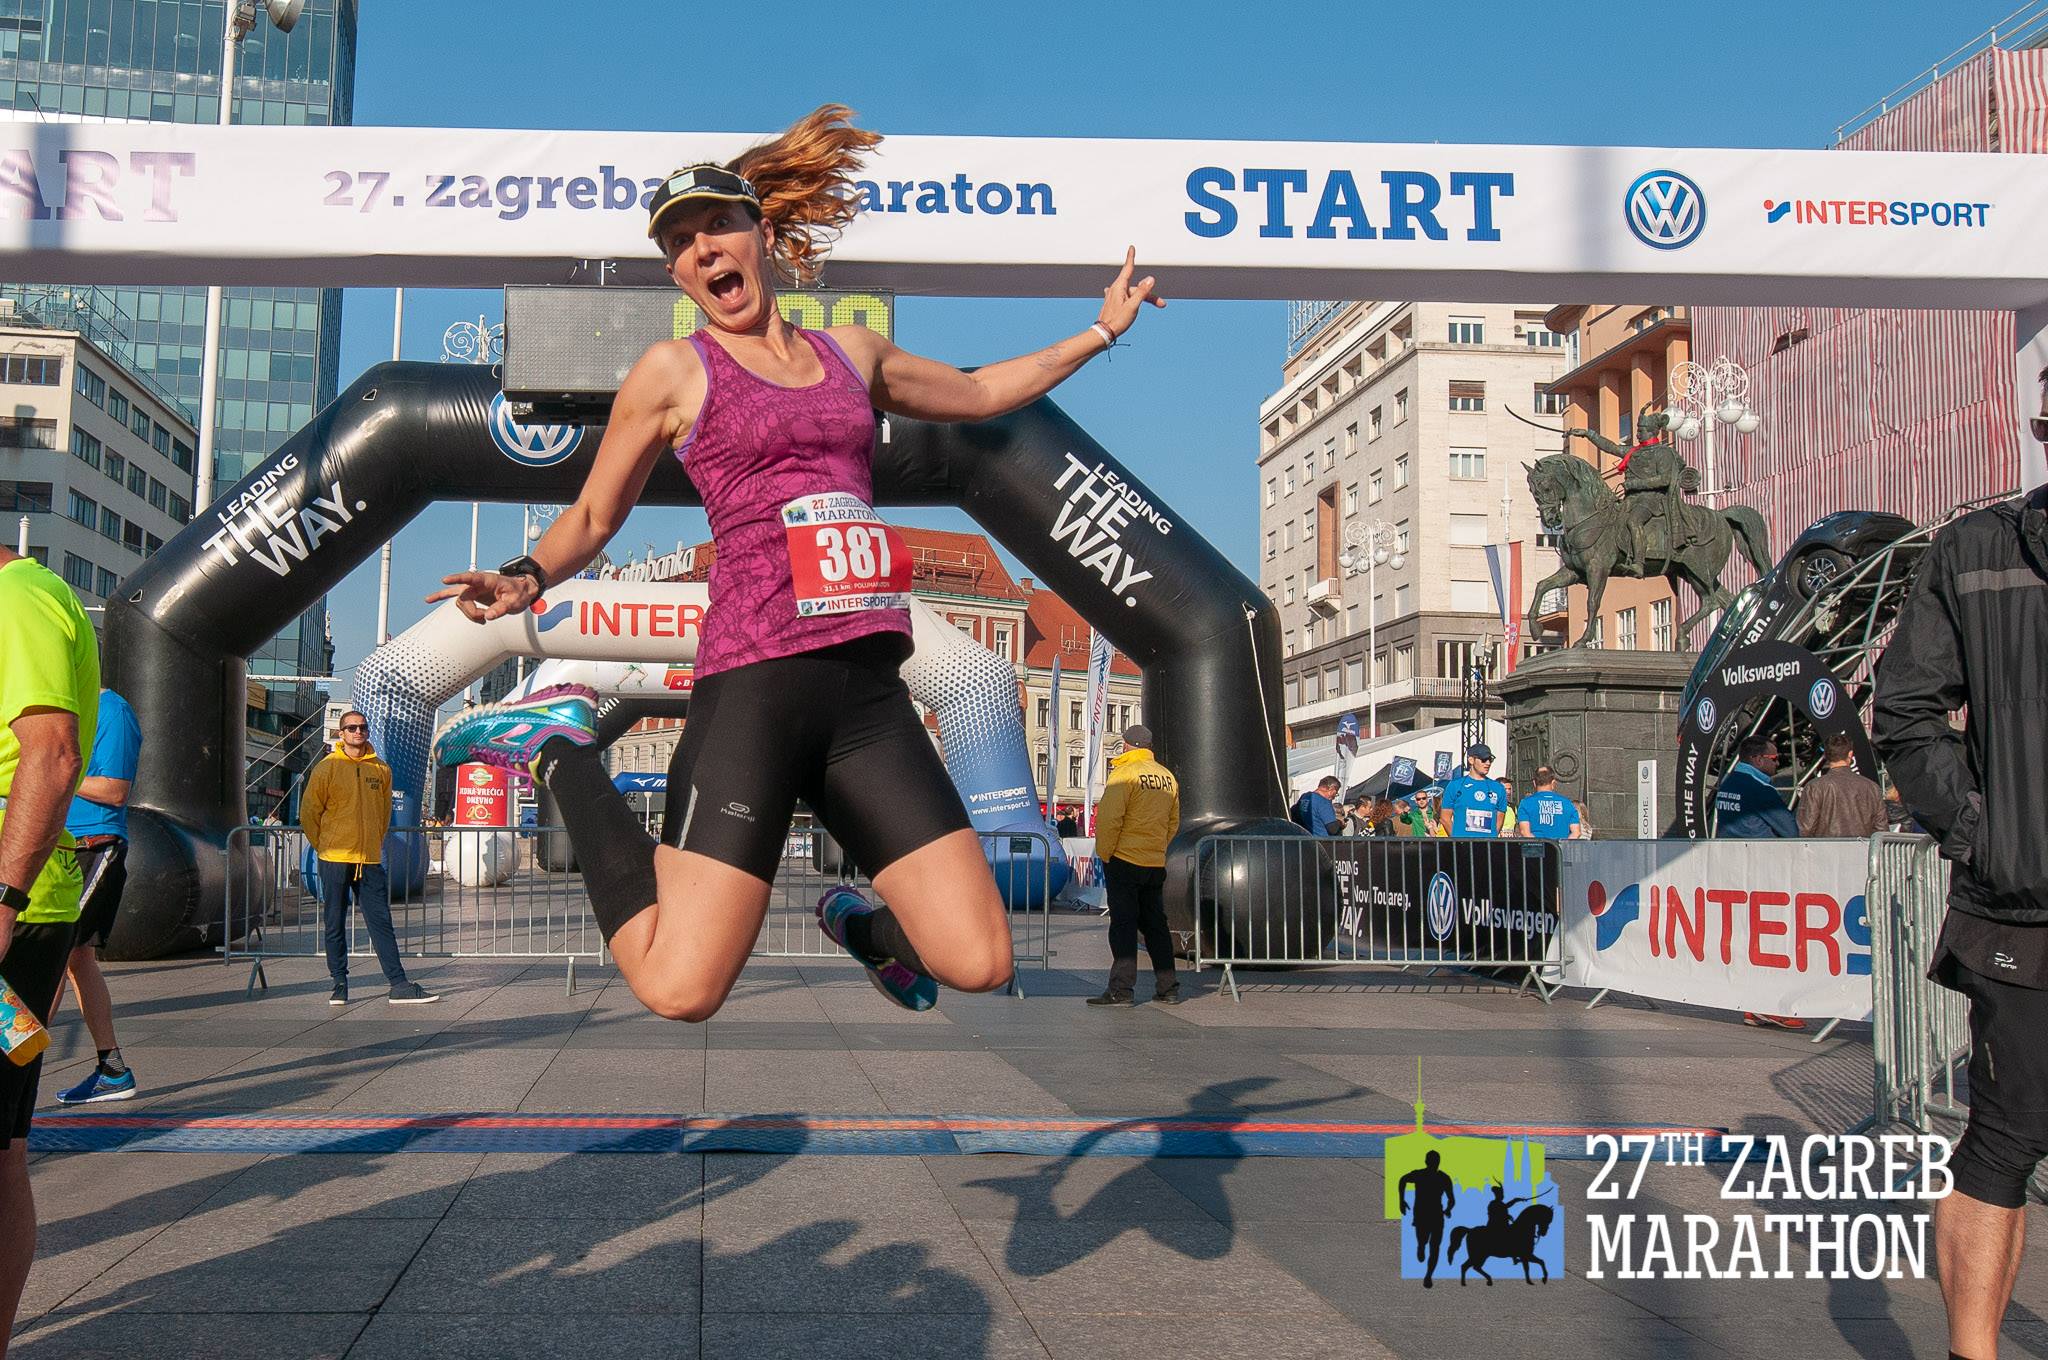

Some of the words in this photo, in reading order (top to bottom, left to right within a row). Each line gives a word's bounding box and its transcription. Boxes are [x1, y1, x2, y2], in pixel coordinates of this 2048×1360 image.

[323, 170, 404, 213] 27.
[832, 173, 1057, 216] araton
[1184, 166, 1515, 241] START
[1796, 199, 1991, 228] INTERSPORT
[217, 453, 299, 525] LEADING
[811, 499, 828, 510] 27.
[1053, 452, 1139, 540] THE
[1093, 462, 1173, 535] LEADING
[201, 485, 297, 567] THE
[250, 481, 367, 577] WAY.
[815, 509, 877, 521] MARATON
[815, 526, 892, 582] 387
[1050, 500, 1153, 607] WAY.
[580, 601, 705, 637] INTER
[827, 596, 892, 611] INTERSPORT
[1722, 661, 1800, 686] Volkswagen
[1139, 774, 1174, 792] REDAR
[1684, 742, 1699, 785] WAY
[971, 801, 1031, 816] www.intersport.si
[978, 787, 1027, 802] INTERSPORT
[1684, 789, 1695, 827] THE
[1461, 898, 1555, 940] Volkswagen
